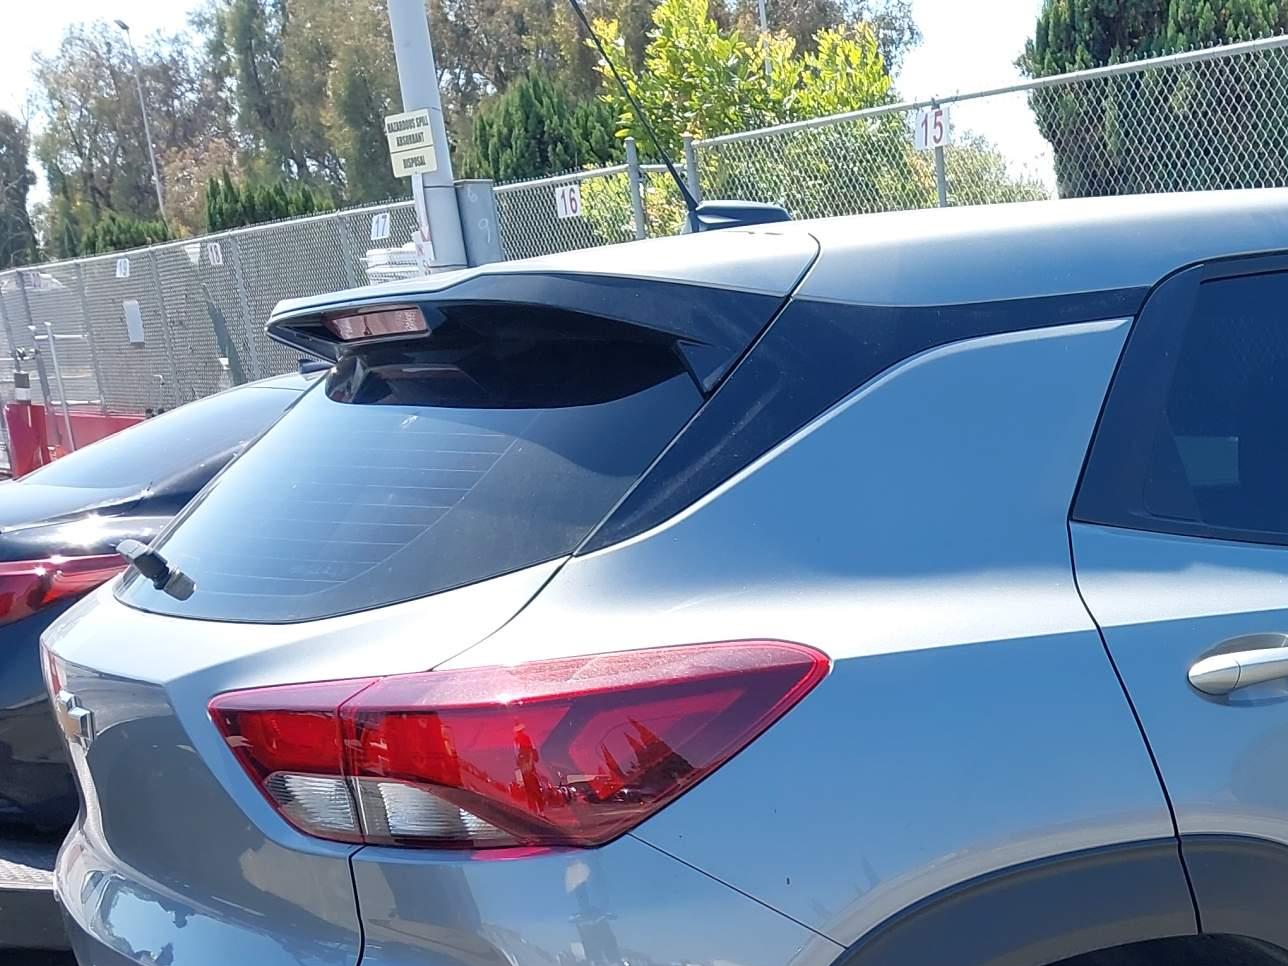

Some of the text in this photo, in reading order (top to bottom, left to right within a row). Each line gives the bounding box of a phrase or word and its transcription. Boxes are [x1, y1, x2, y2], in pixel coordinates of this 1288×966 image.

[387, 116, 428, 133] HAZARDOUS SPILL
[921, 109, 944, 147] 15
[403, 156, 426, 168] DISPOSAL
[560, 187, 578, 215] 16
[375, 215, 388, 237] 17
